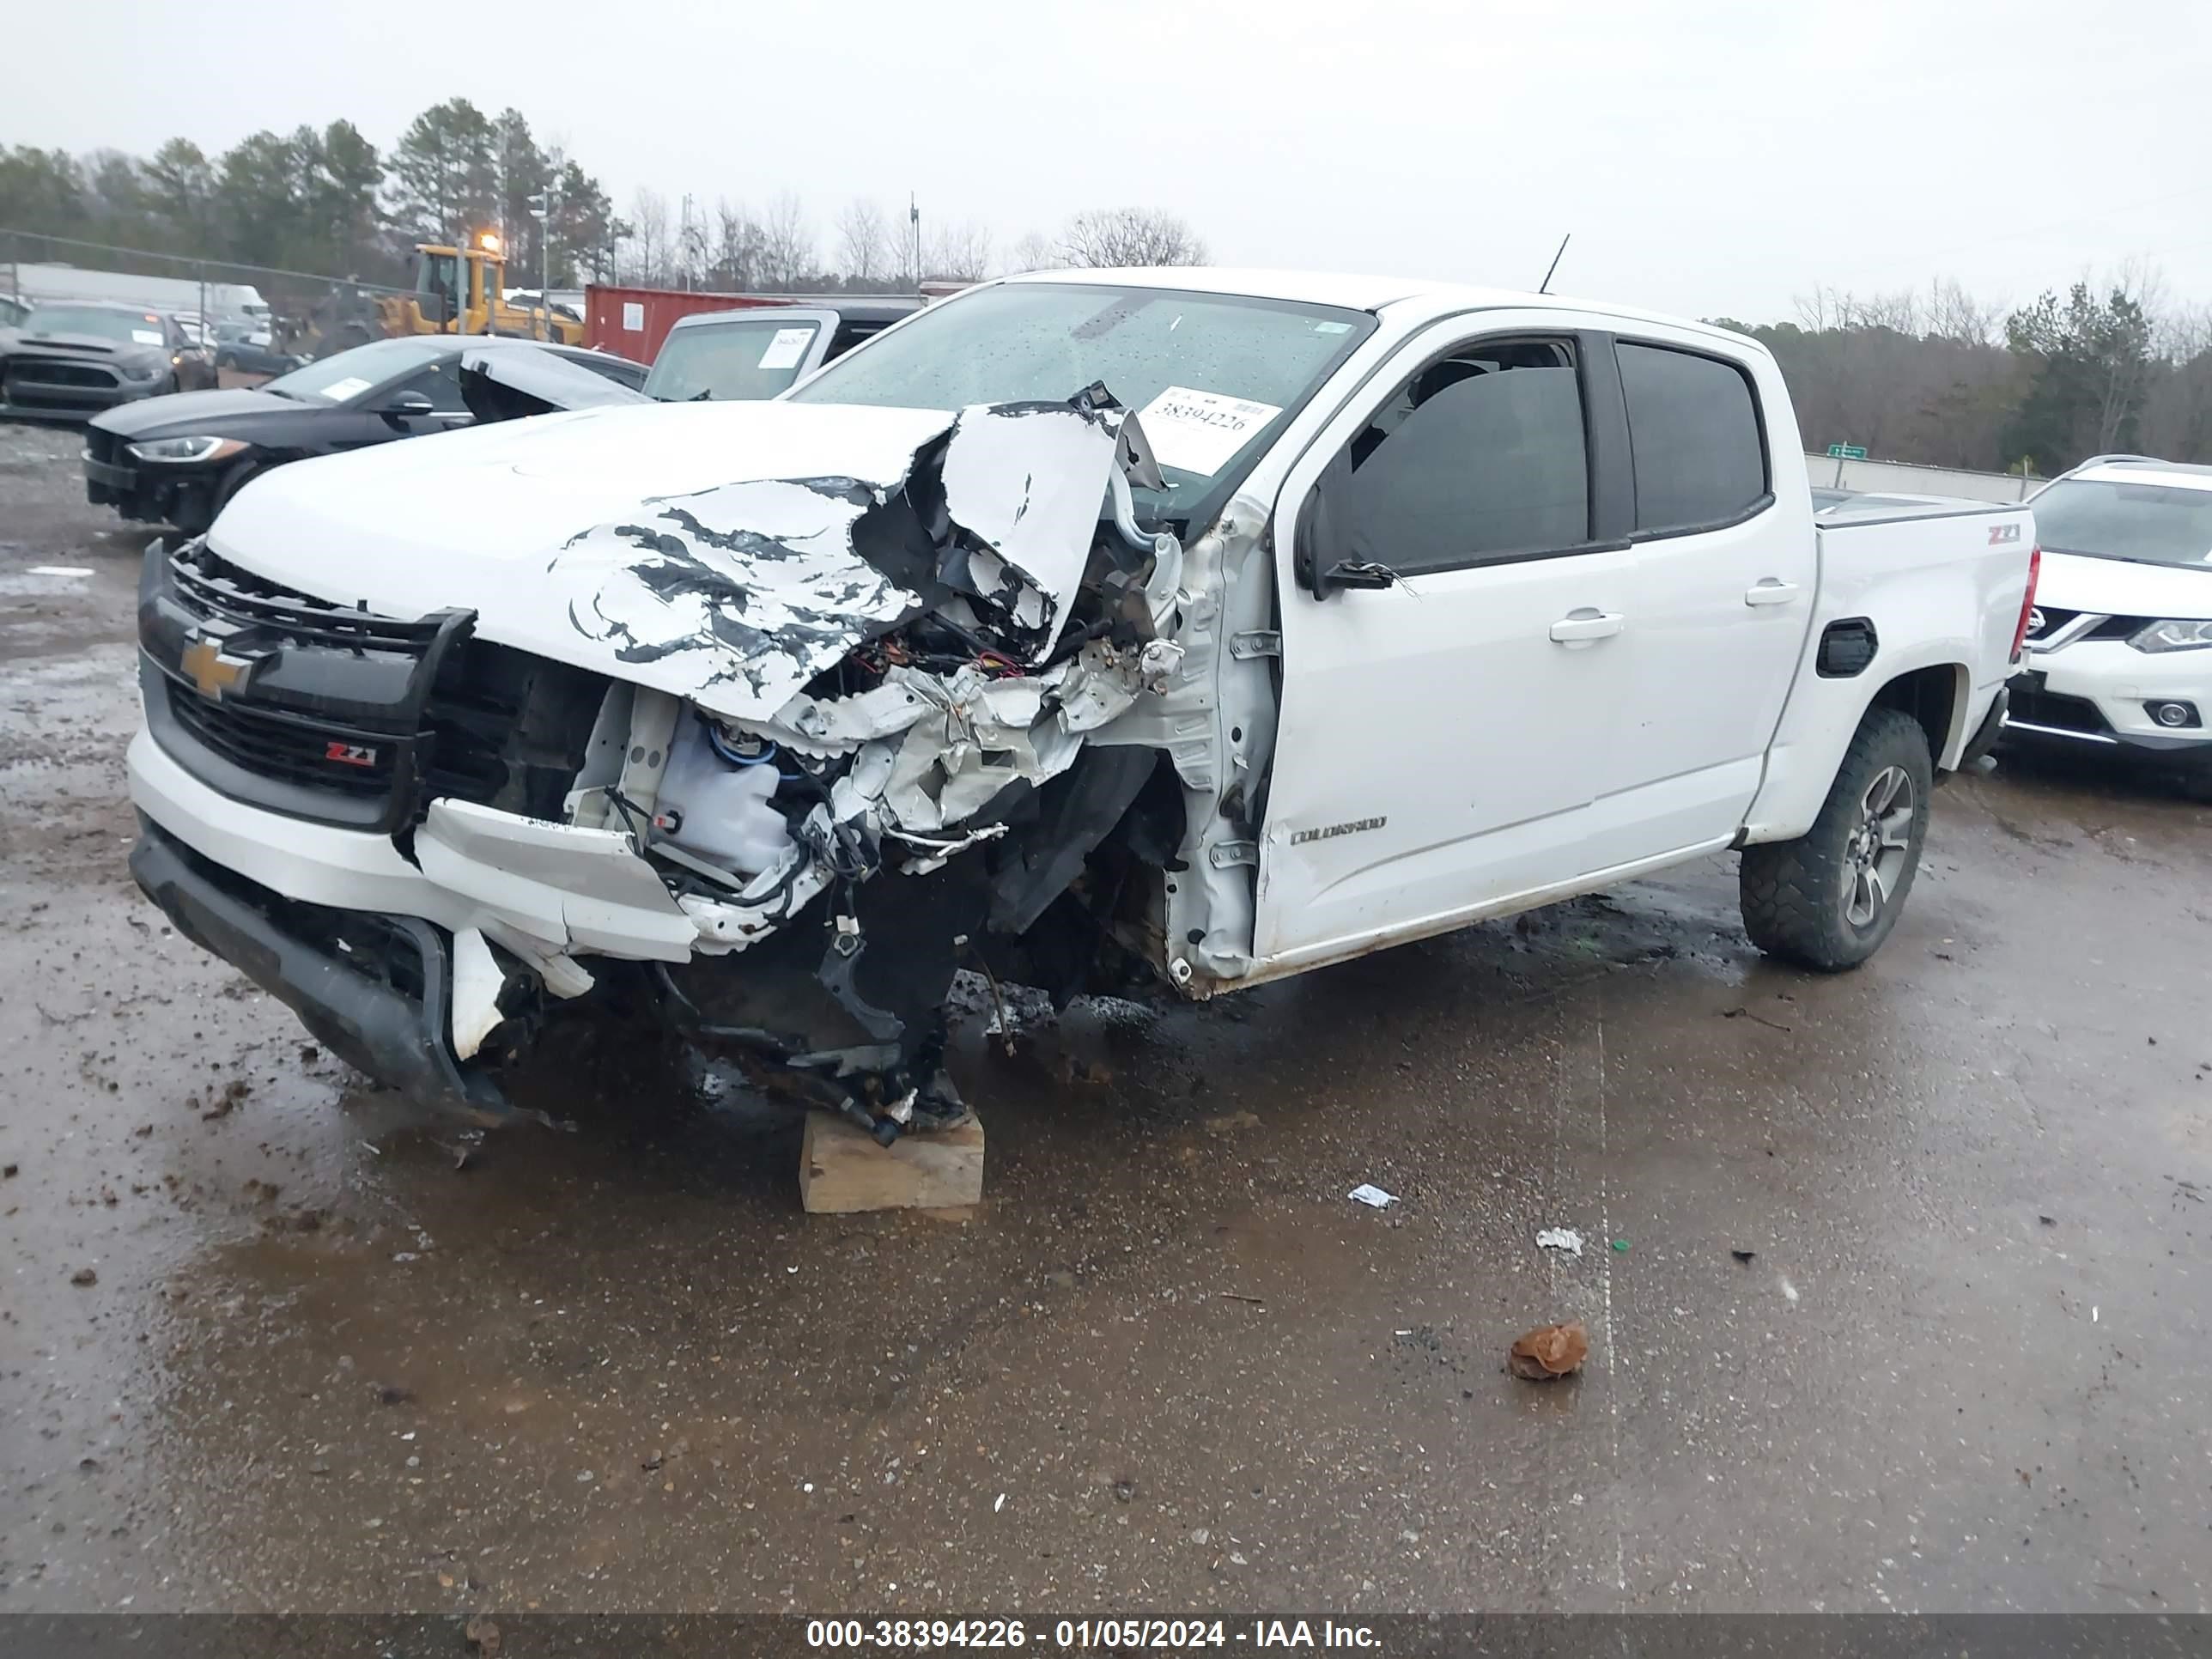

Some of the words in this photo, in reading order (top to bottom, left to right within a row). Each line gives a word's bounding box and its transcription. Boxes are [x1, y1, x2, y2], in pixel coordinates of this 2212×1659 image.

[1154, 402, 1248, 431] 38394226
[1988, 524, 2021, 545] Z71
[325, 741, 377, 767] Z71
[1290, 816, 1388, 846] COLORADO
